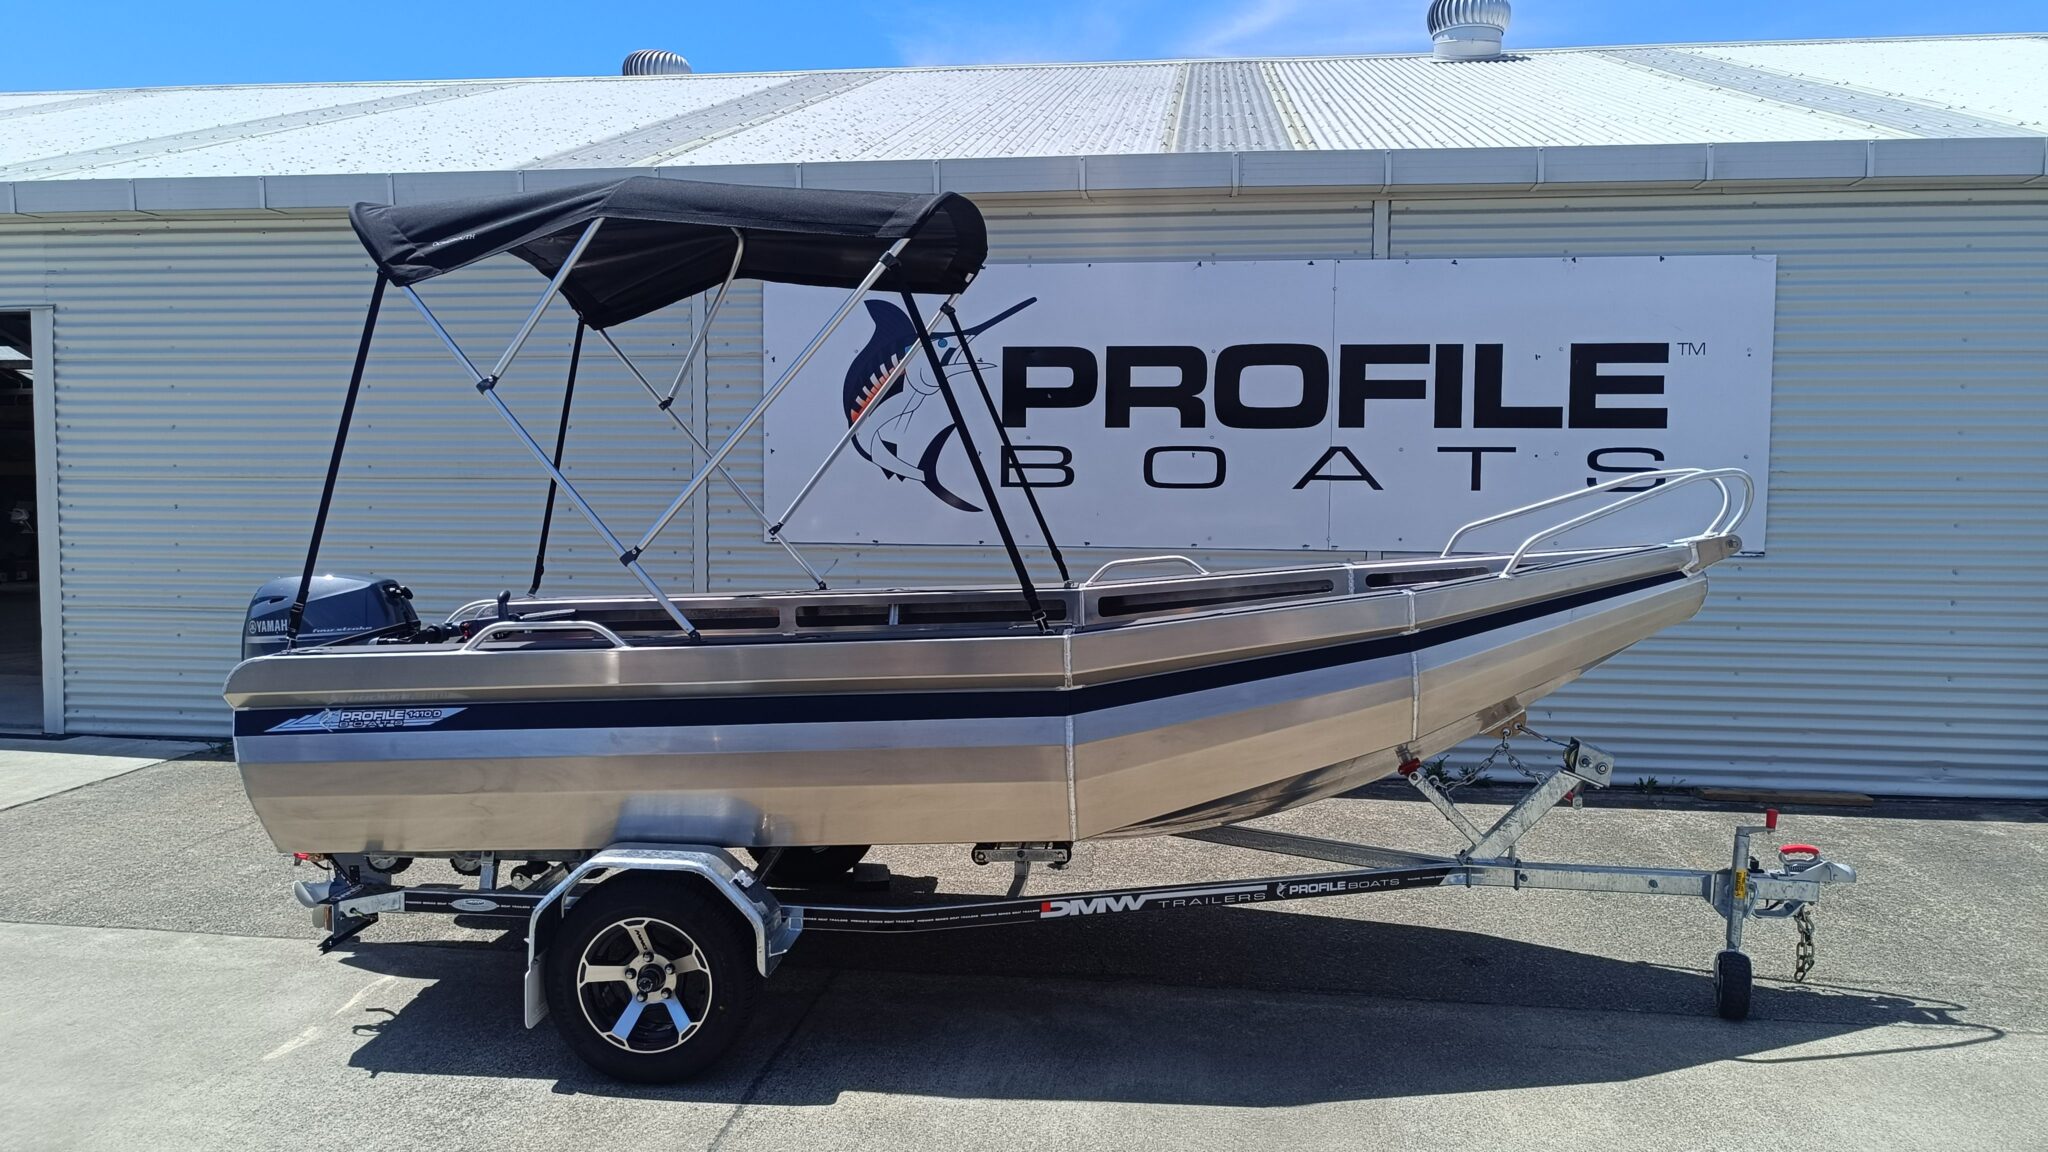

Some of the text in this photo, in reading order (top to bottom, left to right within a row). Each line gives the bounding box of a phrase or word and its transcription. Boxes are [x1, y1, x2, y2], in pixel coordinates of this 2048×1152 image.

[1001, 342, 1706, 429] PROFILE TM
[1000, 446, 1667, 492] BOATS
[257, 619, 288, 633] YAMAH
[339, 720, 404, 729] BOATS
[341, 710, 405, 721] PROFILE
[1289, 880, 1347, 895] PROFILE
[1348, 877, 1400, 890] BOATS
[1041, 896, 1147, 918] DMW
[1157, 891, 1266, 909] TRAILERS
